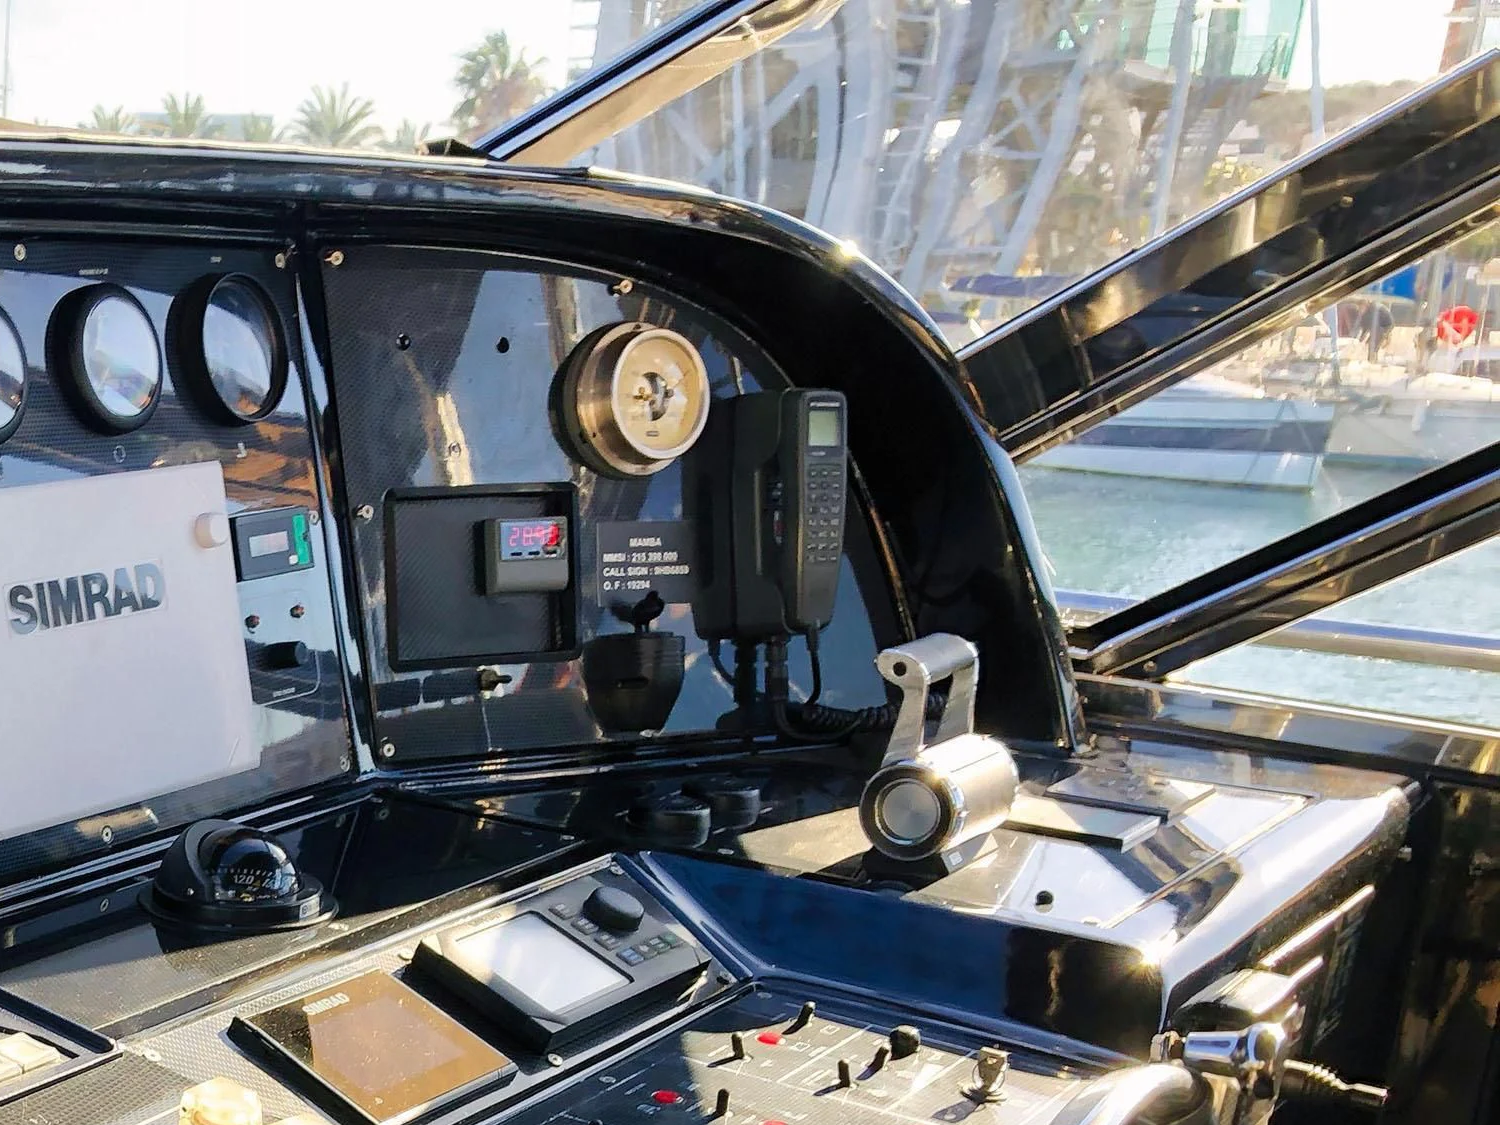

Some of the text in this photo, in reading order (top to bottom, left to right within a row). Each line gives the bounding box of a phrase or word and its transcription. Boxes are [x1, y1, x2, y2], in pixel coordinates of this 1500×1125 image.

[628, 537, 662, 548] MAMBA
[603, 567, 626, 577] CALL
[627, 566, 648, 576] SIGN
[9, 562, 166, 635] SIMRAD
